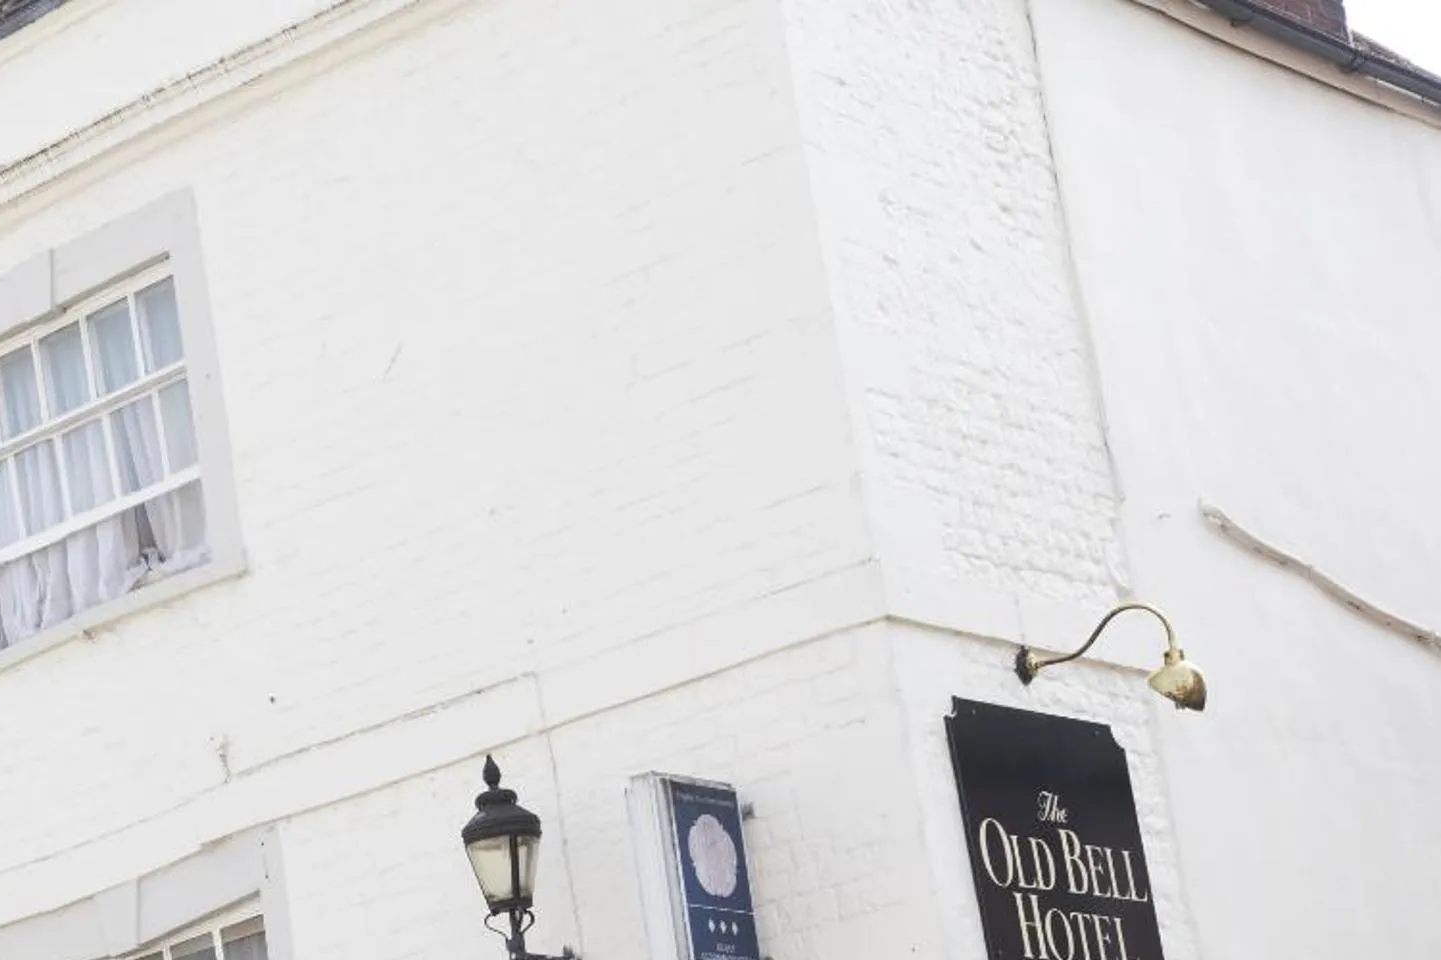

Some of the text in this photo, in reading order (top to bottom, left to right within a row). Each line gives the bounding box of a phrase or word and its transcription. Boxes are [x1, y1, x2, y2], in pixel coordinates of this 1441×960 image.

[1037, 790, 1068, 824] The
[979, 817, 1148, 902] OLD BELL
